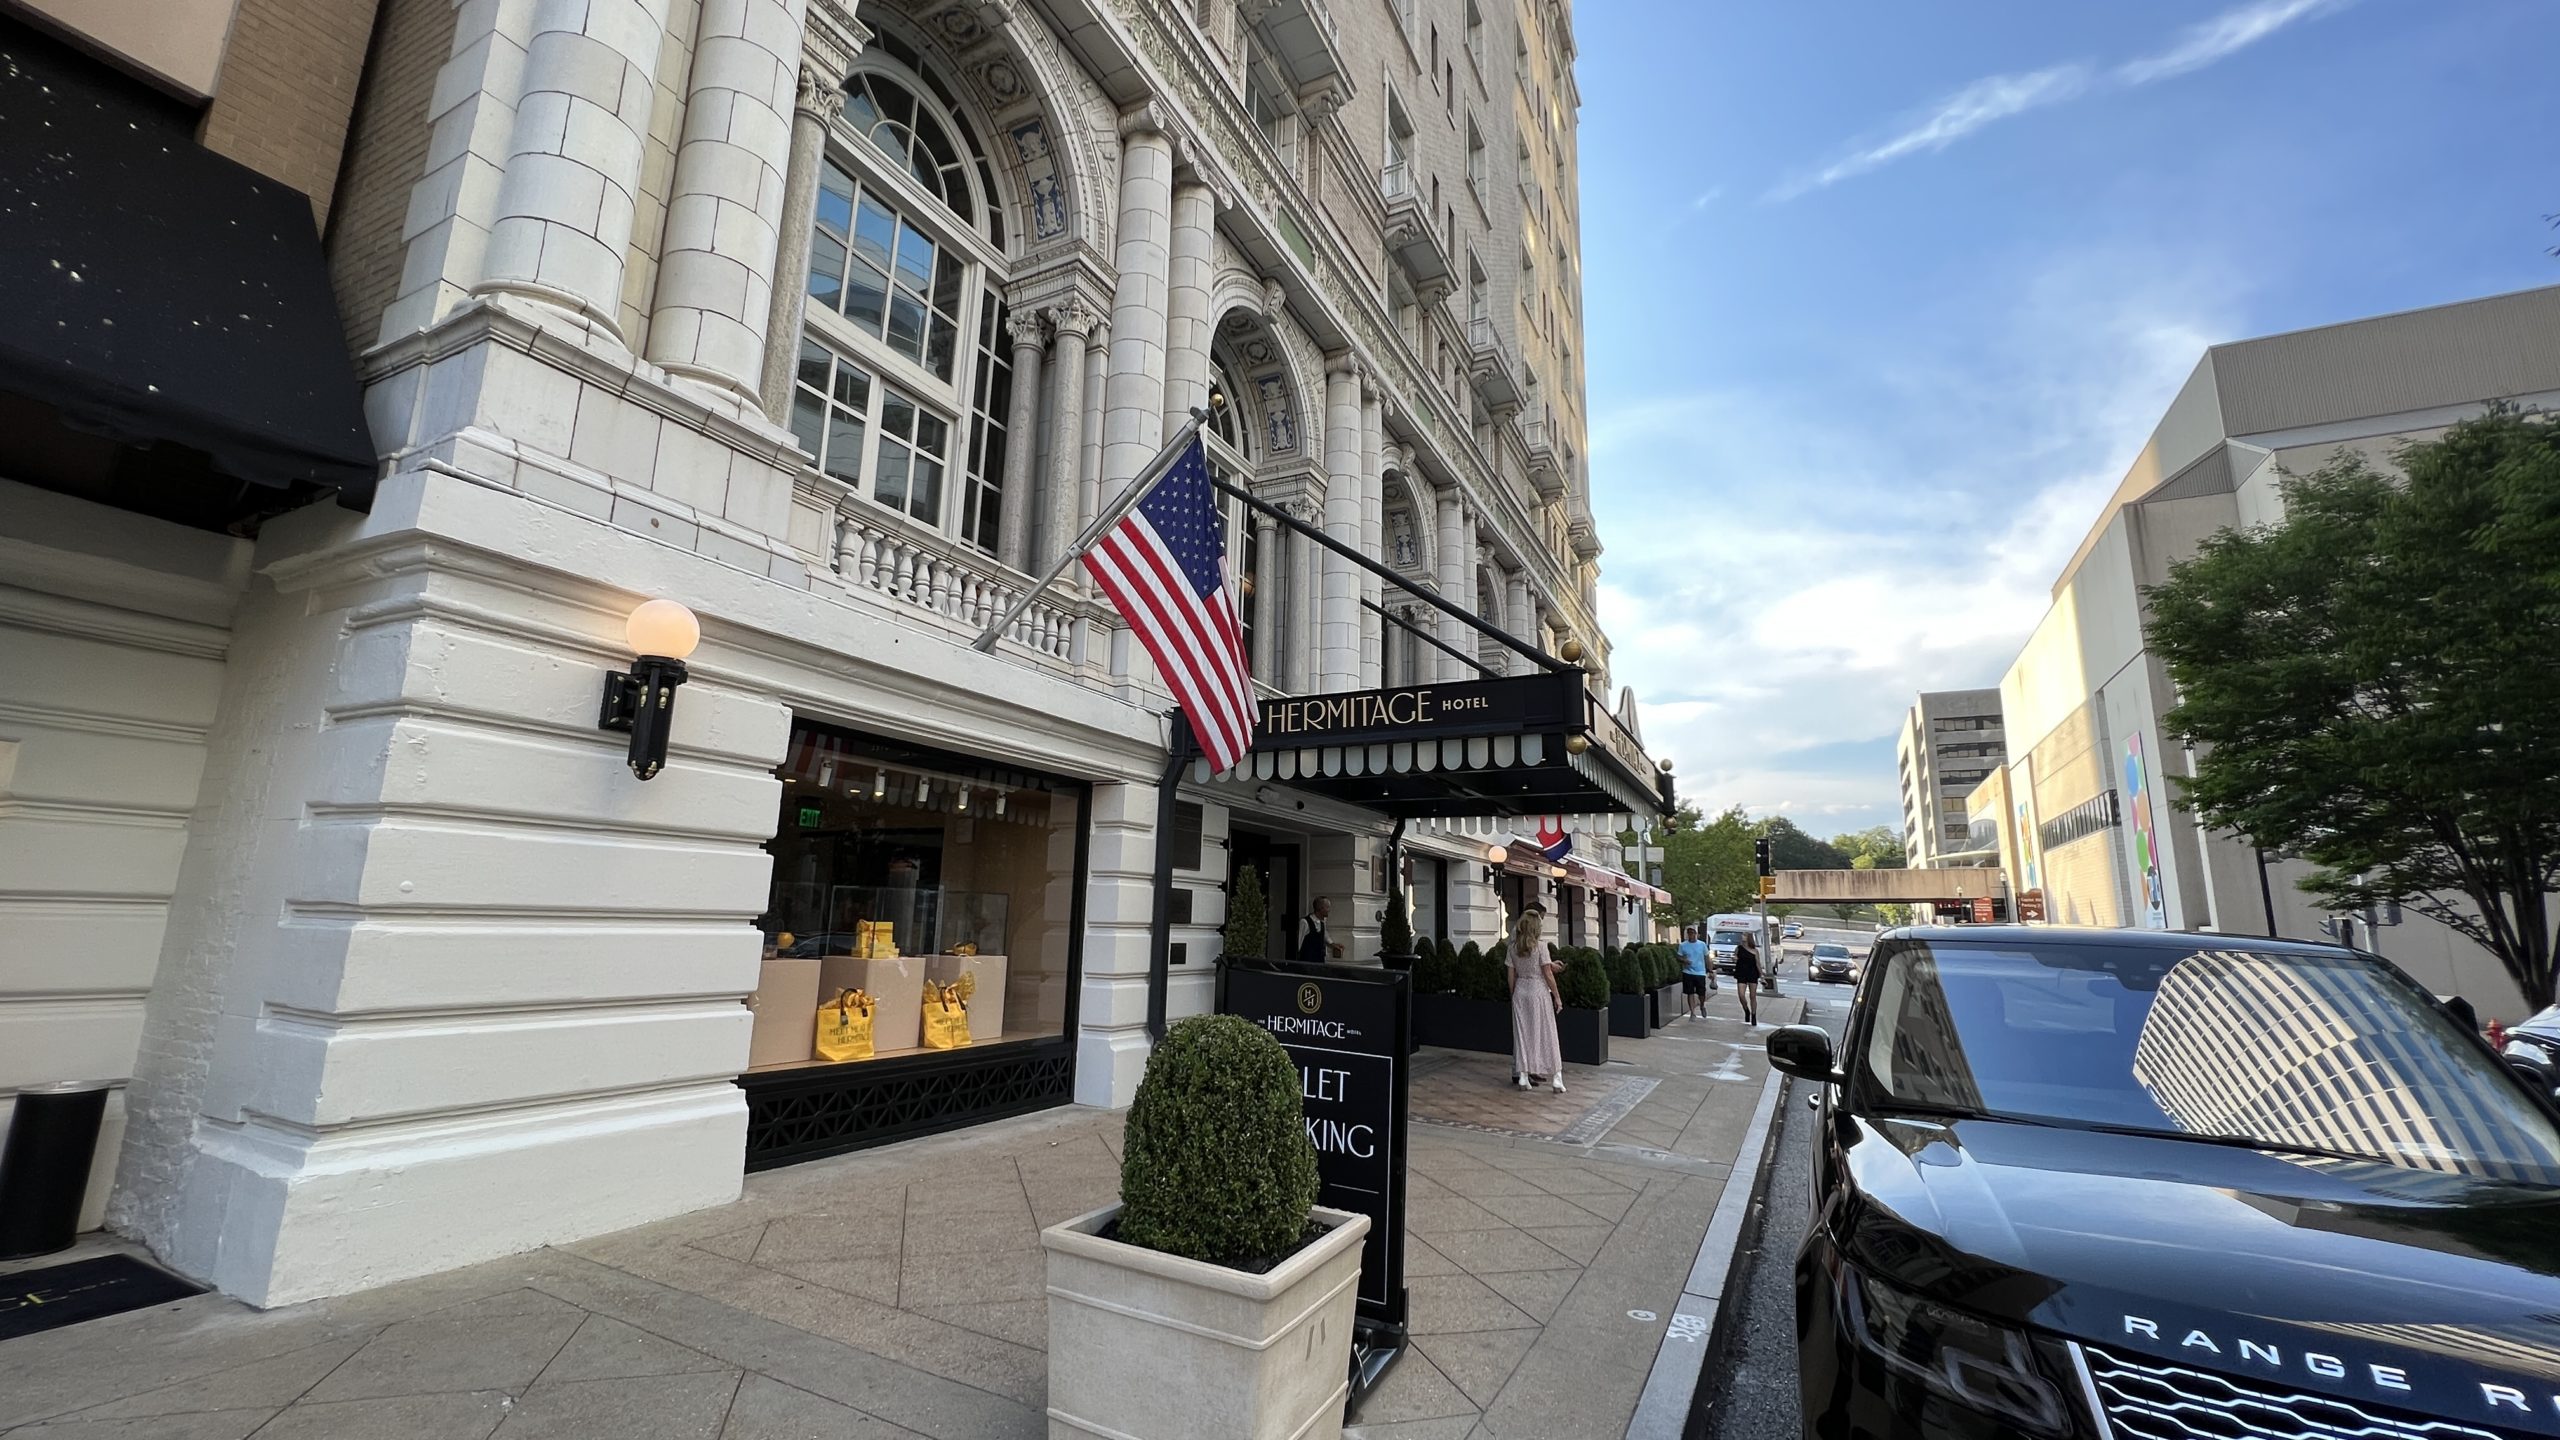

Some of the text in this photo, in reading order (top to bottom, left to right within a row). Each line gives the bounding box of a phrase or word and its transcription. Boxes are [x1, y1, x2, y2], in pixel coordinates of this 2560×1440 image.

[1268, 690, 1489, 734] HERMITAGE HOTEL
[799, 808, 821, 828] EXIT
[1267, 1014, 1346, 1039] HERMITAGE
[1303, 1065, 1351, 1102] LET
[1305, 1116, 1374, 1158] KING
[2123, 1314, 2560, 1414] RANGE R
